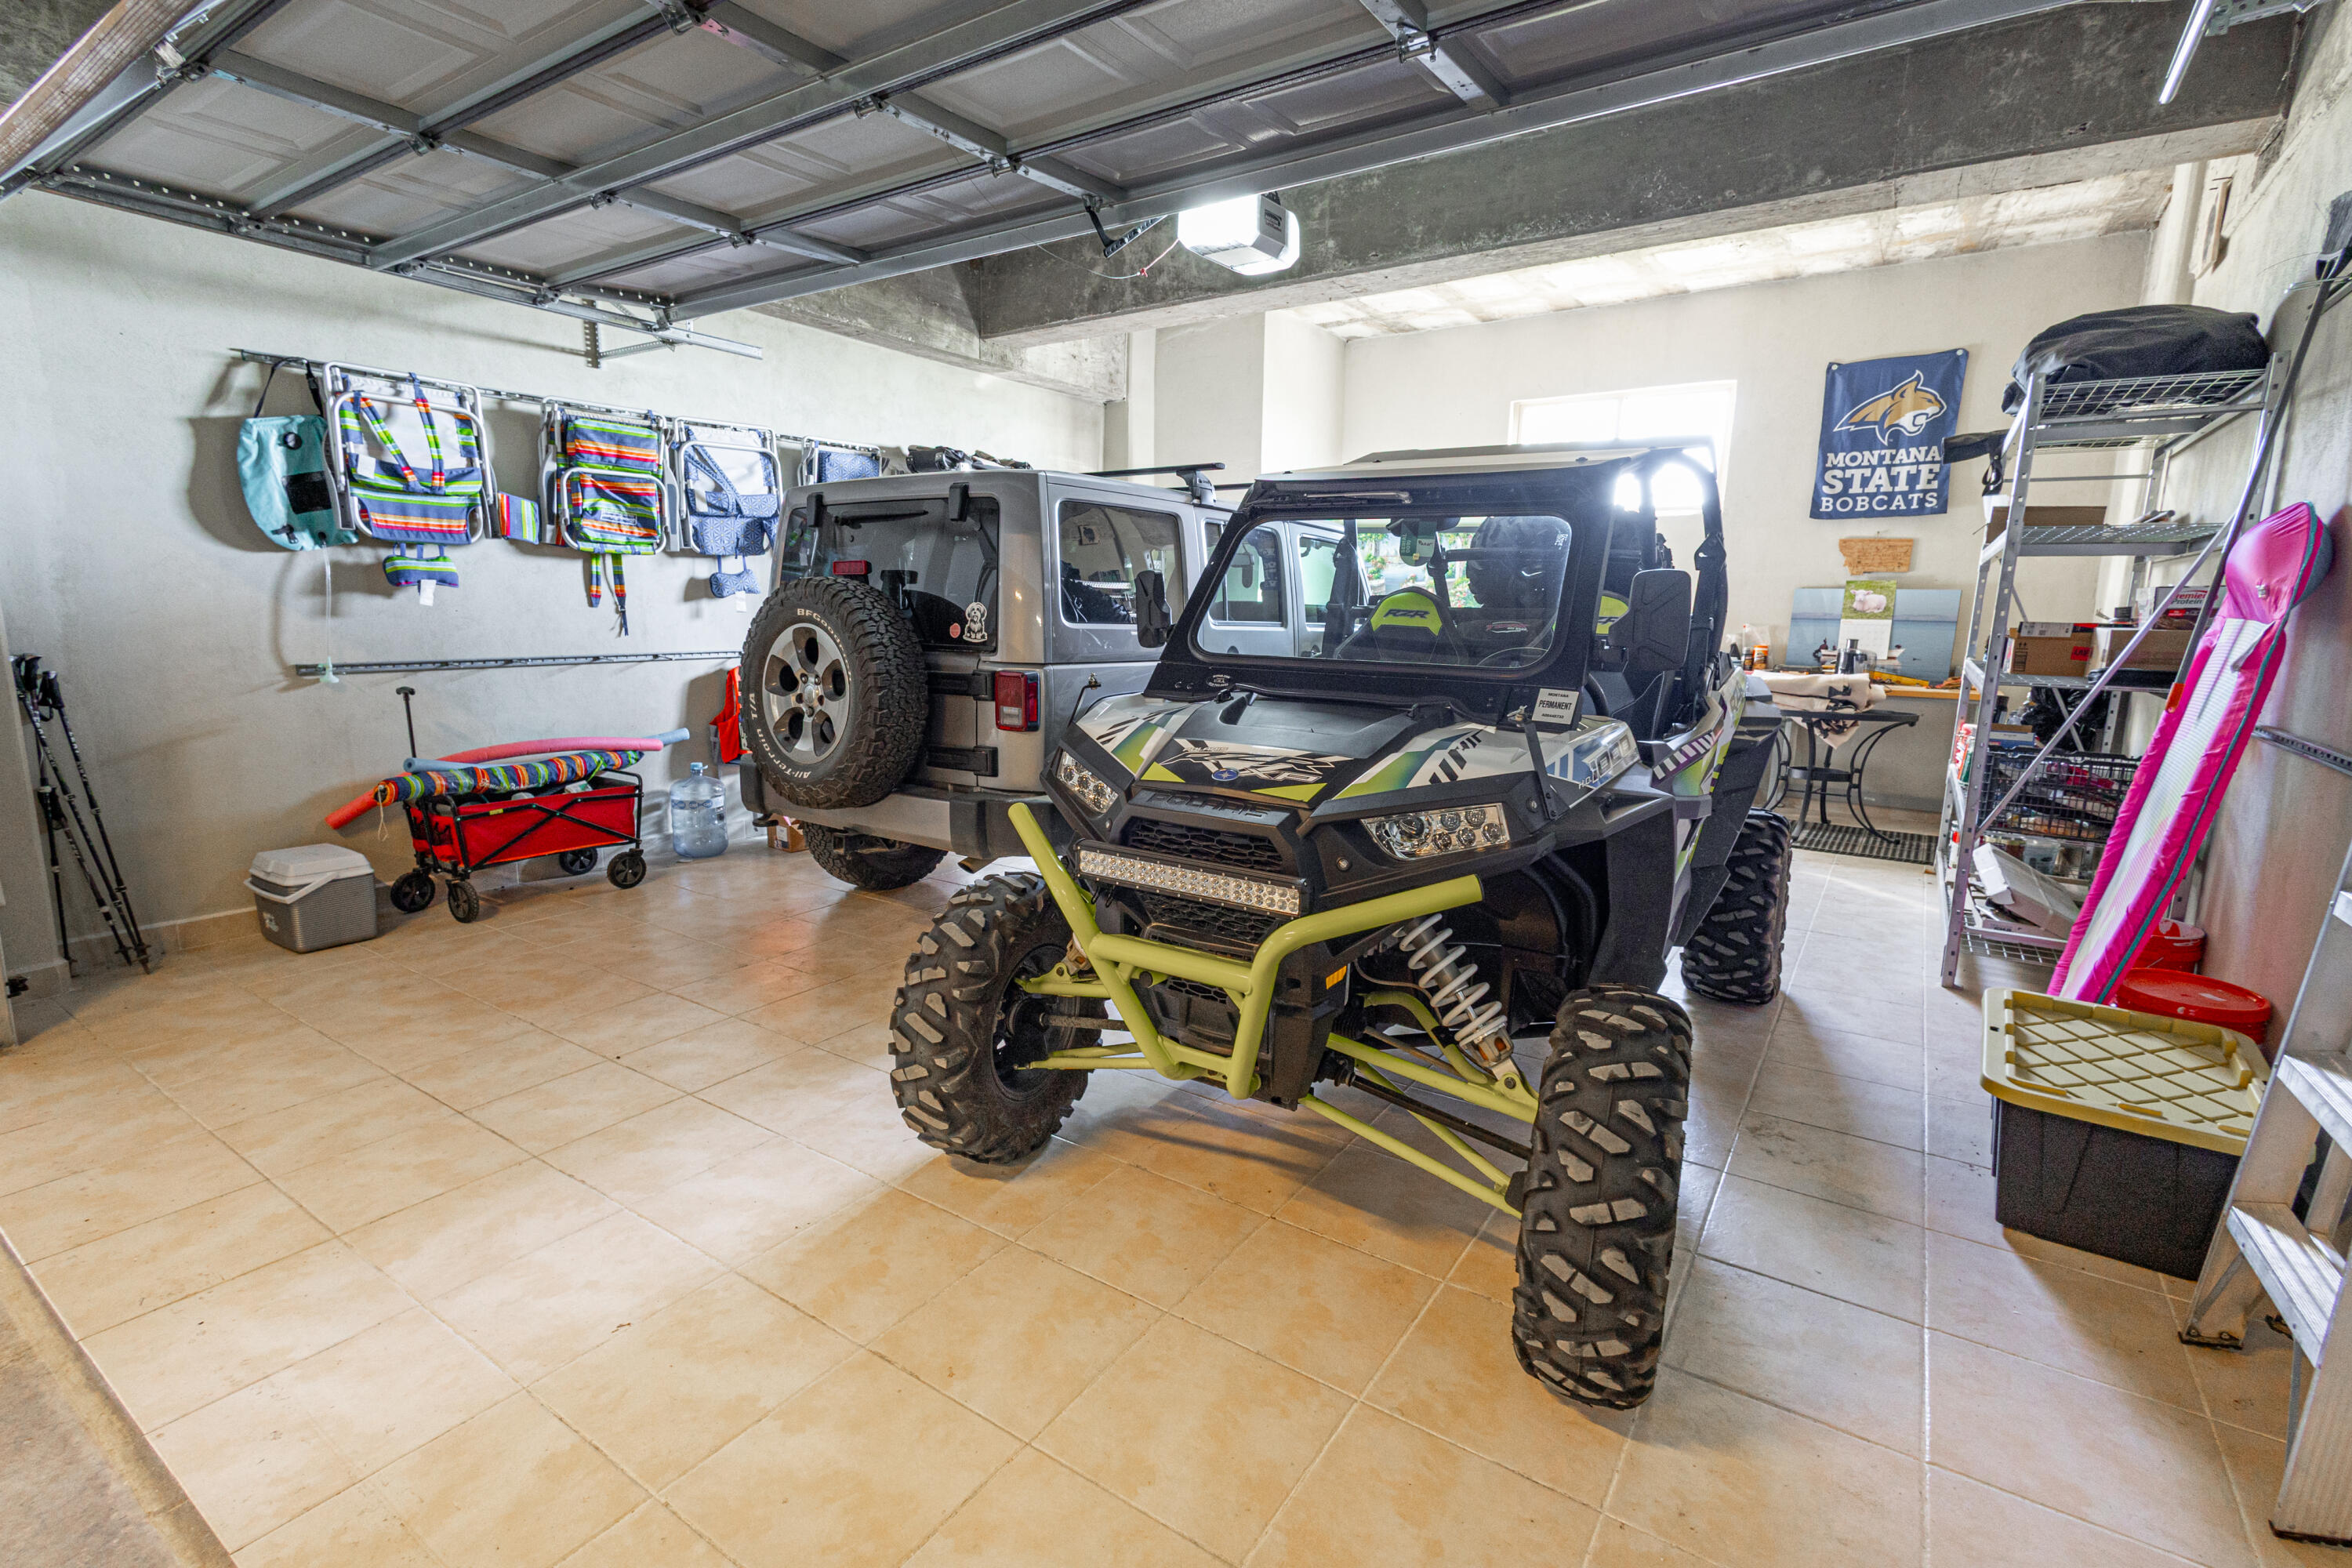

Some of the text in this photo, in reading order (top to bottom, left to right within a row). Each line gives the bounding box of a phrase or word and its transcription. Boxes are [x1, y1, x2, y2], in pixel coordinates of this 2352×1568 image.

[1825, 445, 1942, 467] MONTANA
[1822, 463, 1940, 495] STATE
[1820, 492, 1938, 512] BOBCATS
[1383, 608, 1430, 619] RZR
[749, 692, 759, 720] T/A
[1538, 699, 1573, 710] PERMANENT
[1147, 792, 1272, 818] POLARIS
